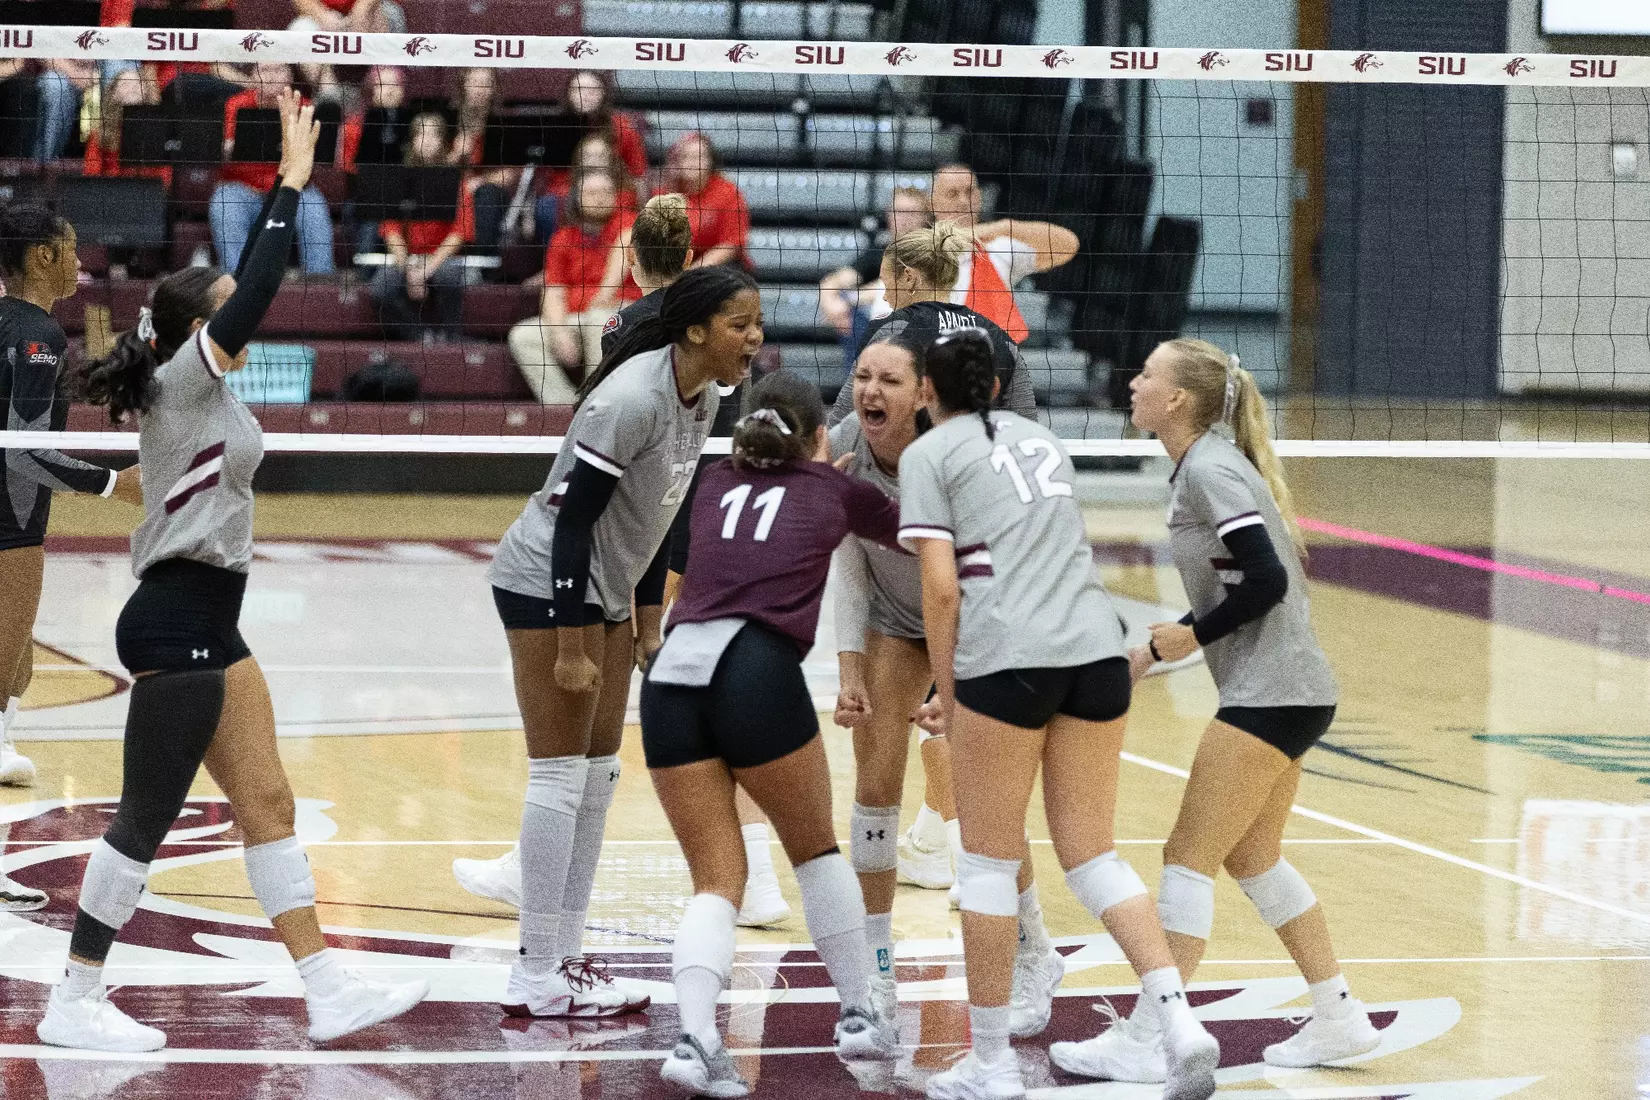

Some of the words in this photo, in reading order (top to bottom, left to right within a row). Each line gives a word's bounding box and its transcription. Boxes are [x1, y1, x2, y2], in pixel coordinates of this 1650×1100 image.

[0, 29, 33, 49] IU
[148, 32, 199, 51] SIU
[312, 35, 362, 55] SIU
[475, 39, 525, 59] SIU
[636, 42, 686, 62] SIU
[795, 46, 845, 65] SIU
[954, 48, 1003, 68] SIU
[1111, 51, 1159, 70] SIU
[1266, 53, 1313, 72] SIU
[1419, 56, 1466, 76] SIU
[1570, 59, 1617, 78] SIU
[30, 353, 58, 365] SEMO
[989, 437, 1074, 504] 12
[719, 483, 787, 542] 11
